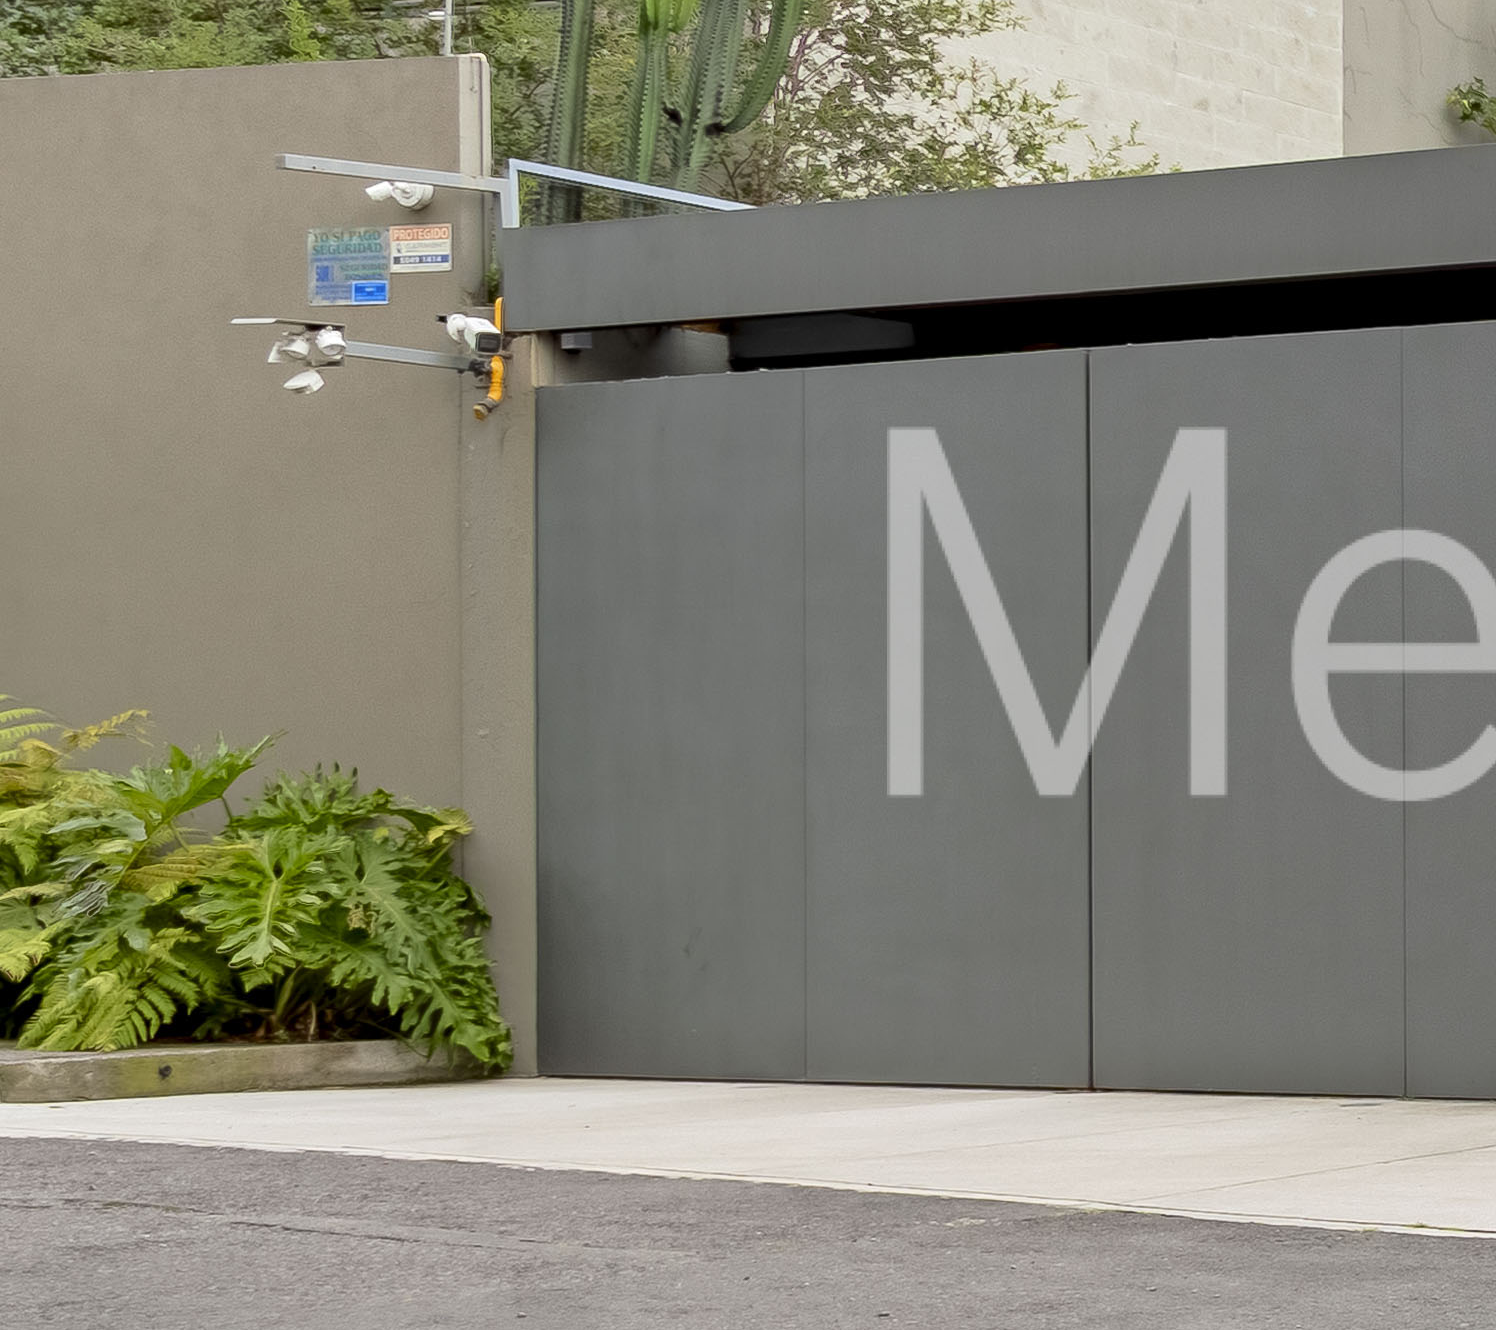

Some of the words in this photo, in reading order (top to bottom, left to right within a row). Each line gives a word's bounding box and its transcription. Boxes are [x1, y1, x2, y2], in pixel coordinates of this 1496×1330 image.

[313, 232, 329, 243] YO
[333, 231, 344, 243] SI
[349, 230, 381, 242] PAGO
[393, 227, 449, 240] PROTEGIDO
[312, 242, 383, 256] SEGURIDAD
